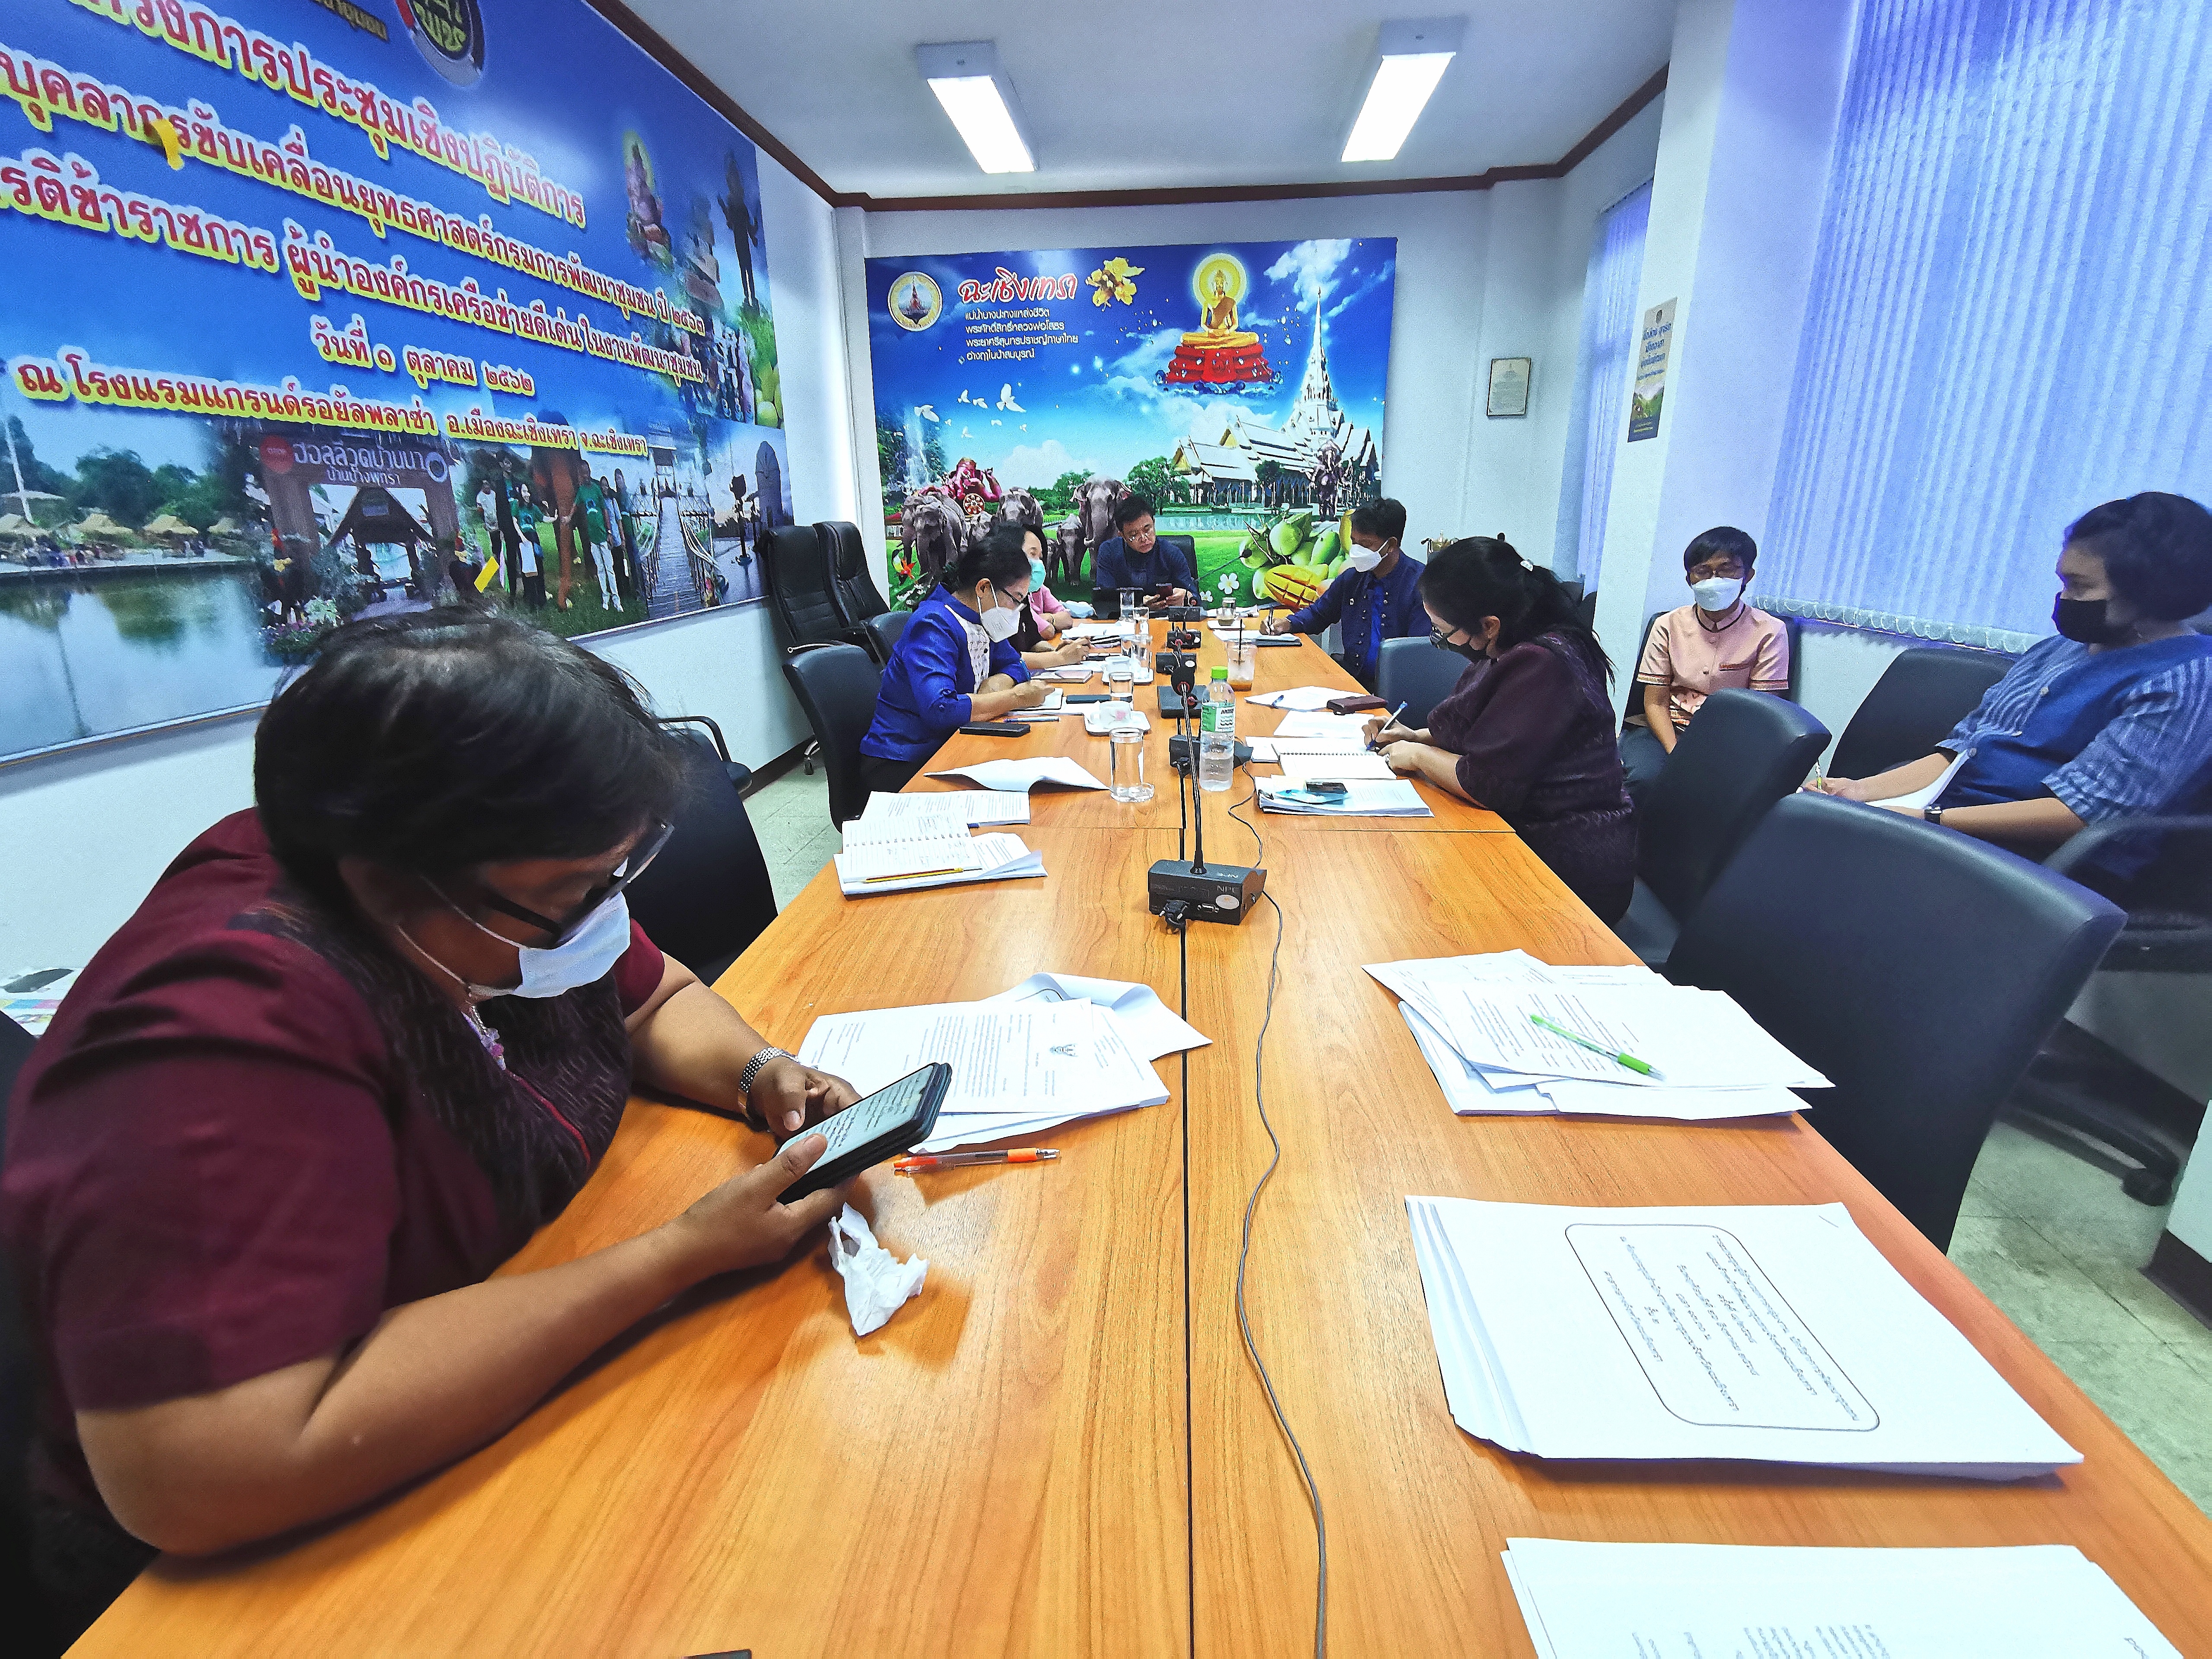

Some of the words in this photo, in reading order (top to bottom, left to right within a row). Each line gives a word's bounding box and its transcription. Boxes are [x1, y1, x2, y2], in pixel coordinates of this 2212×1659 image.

[86, 0, 585, 224] รงการประชุมเชิงปฏิบัติการ
[0, 157, 275, 266] รติข้าราชการ
[957, 266, 1078, 303] ฉะเชิงเทรา
[406, 351, 474, 385] ตุลาคม
[484, 366, 533, 392] ๒๕๖๒
